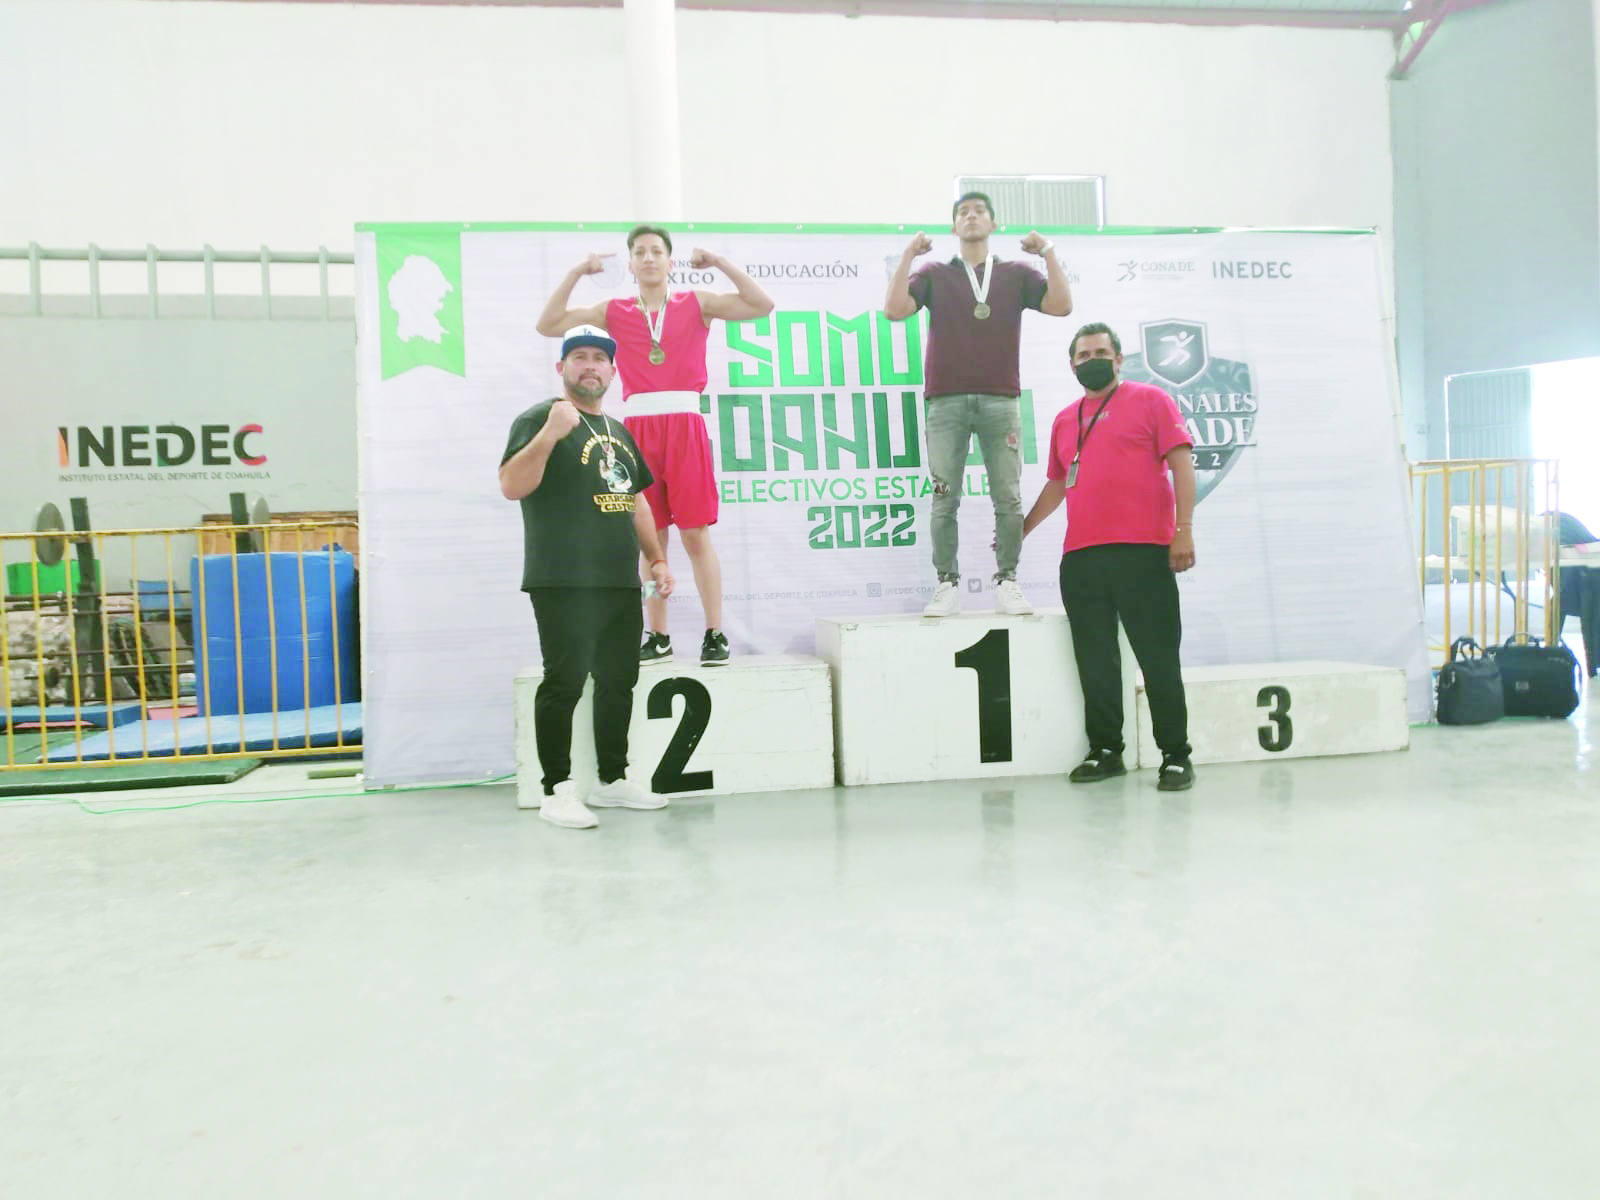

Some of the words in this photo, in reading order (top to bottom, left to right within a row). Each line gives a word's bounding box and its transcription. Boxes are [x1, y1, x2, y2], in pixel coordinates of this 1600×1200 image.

[745, 260, 859, 279] EDUCACIÓN
[1140, 261, 1196, 273] CONADE
[1211, 260, 1293, 279] INEDEC
[726, 310, 931, 388] SOMO
[1176, 392, 1258, 414] NALES
[57, 423, 268, 468] INEDEC
[1184, 417, 1257, 447] ADE
[58, 473, 107, 483] INSTITUTO
[108, 472, 145, 482] ESTATAL
[147, 472, 164, 482] DEL
[167, 471, 209, 481] DEPORTE
[211, 471, 222, 480] DE
[225, 470, 271, 481] COAHUILA
[716, 477, 868, 504] ELECTIVOS
[807, 503, 917, 550] 2022
[954, 629, 1012, 763] 1
[1256, 686, 1293, 752] 3
[646, 677, 713, 793] 2
